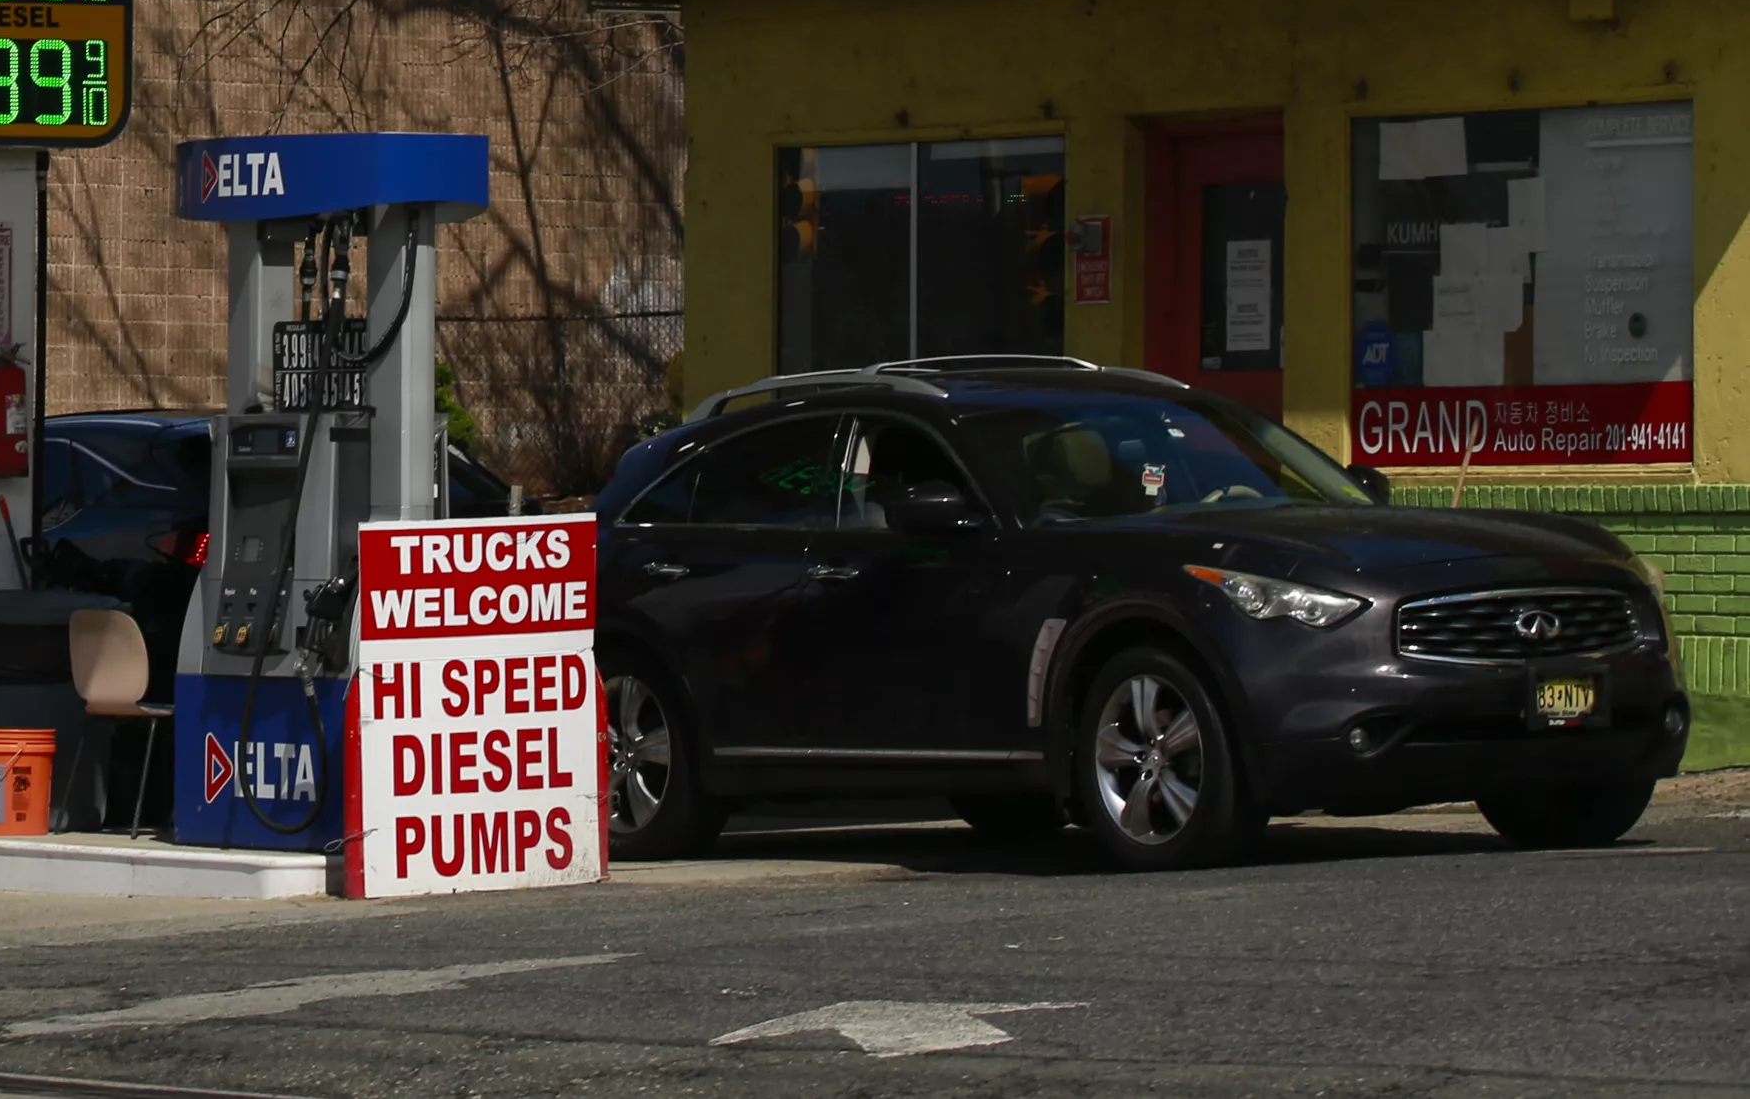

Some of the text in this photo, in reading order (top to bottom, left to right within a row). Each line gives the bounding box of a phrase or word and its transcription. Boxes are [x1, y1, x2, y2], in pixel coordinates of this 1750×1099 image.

[1585, 113, 1691, 137] COMPLETE SERVICE
[1387, 222, 1439, 244] KUMH
[1585, 275, 1649, 293] Suspension
[1585, 298, 1625, 315] Muffler
[1584, 322, 1617, 339] Brake
[1362, 342, 1390, 365] ADT
[1600, 344, 1658, 362] Inspection
[1494, 402, 1539, 425] 자동차
[1359, 400, 1488, 455] GRAND
[1494, 421, 1687, 458] Auto Repair 201-941-4141
[390, 529, 571, 575] TRUCKS
[370, 581, 587, 630] WELCOME
[372, 655, 586, 720] HI SPEED
[392, 727, 573, 797] DIESEL
[395, 806, 574, 879] PUMPS
